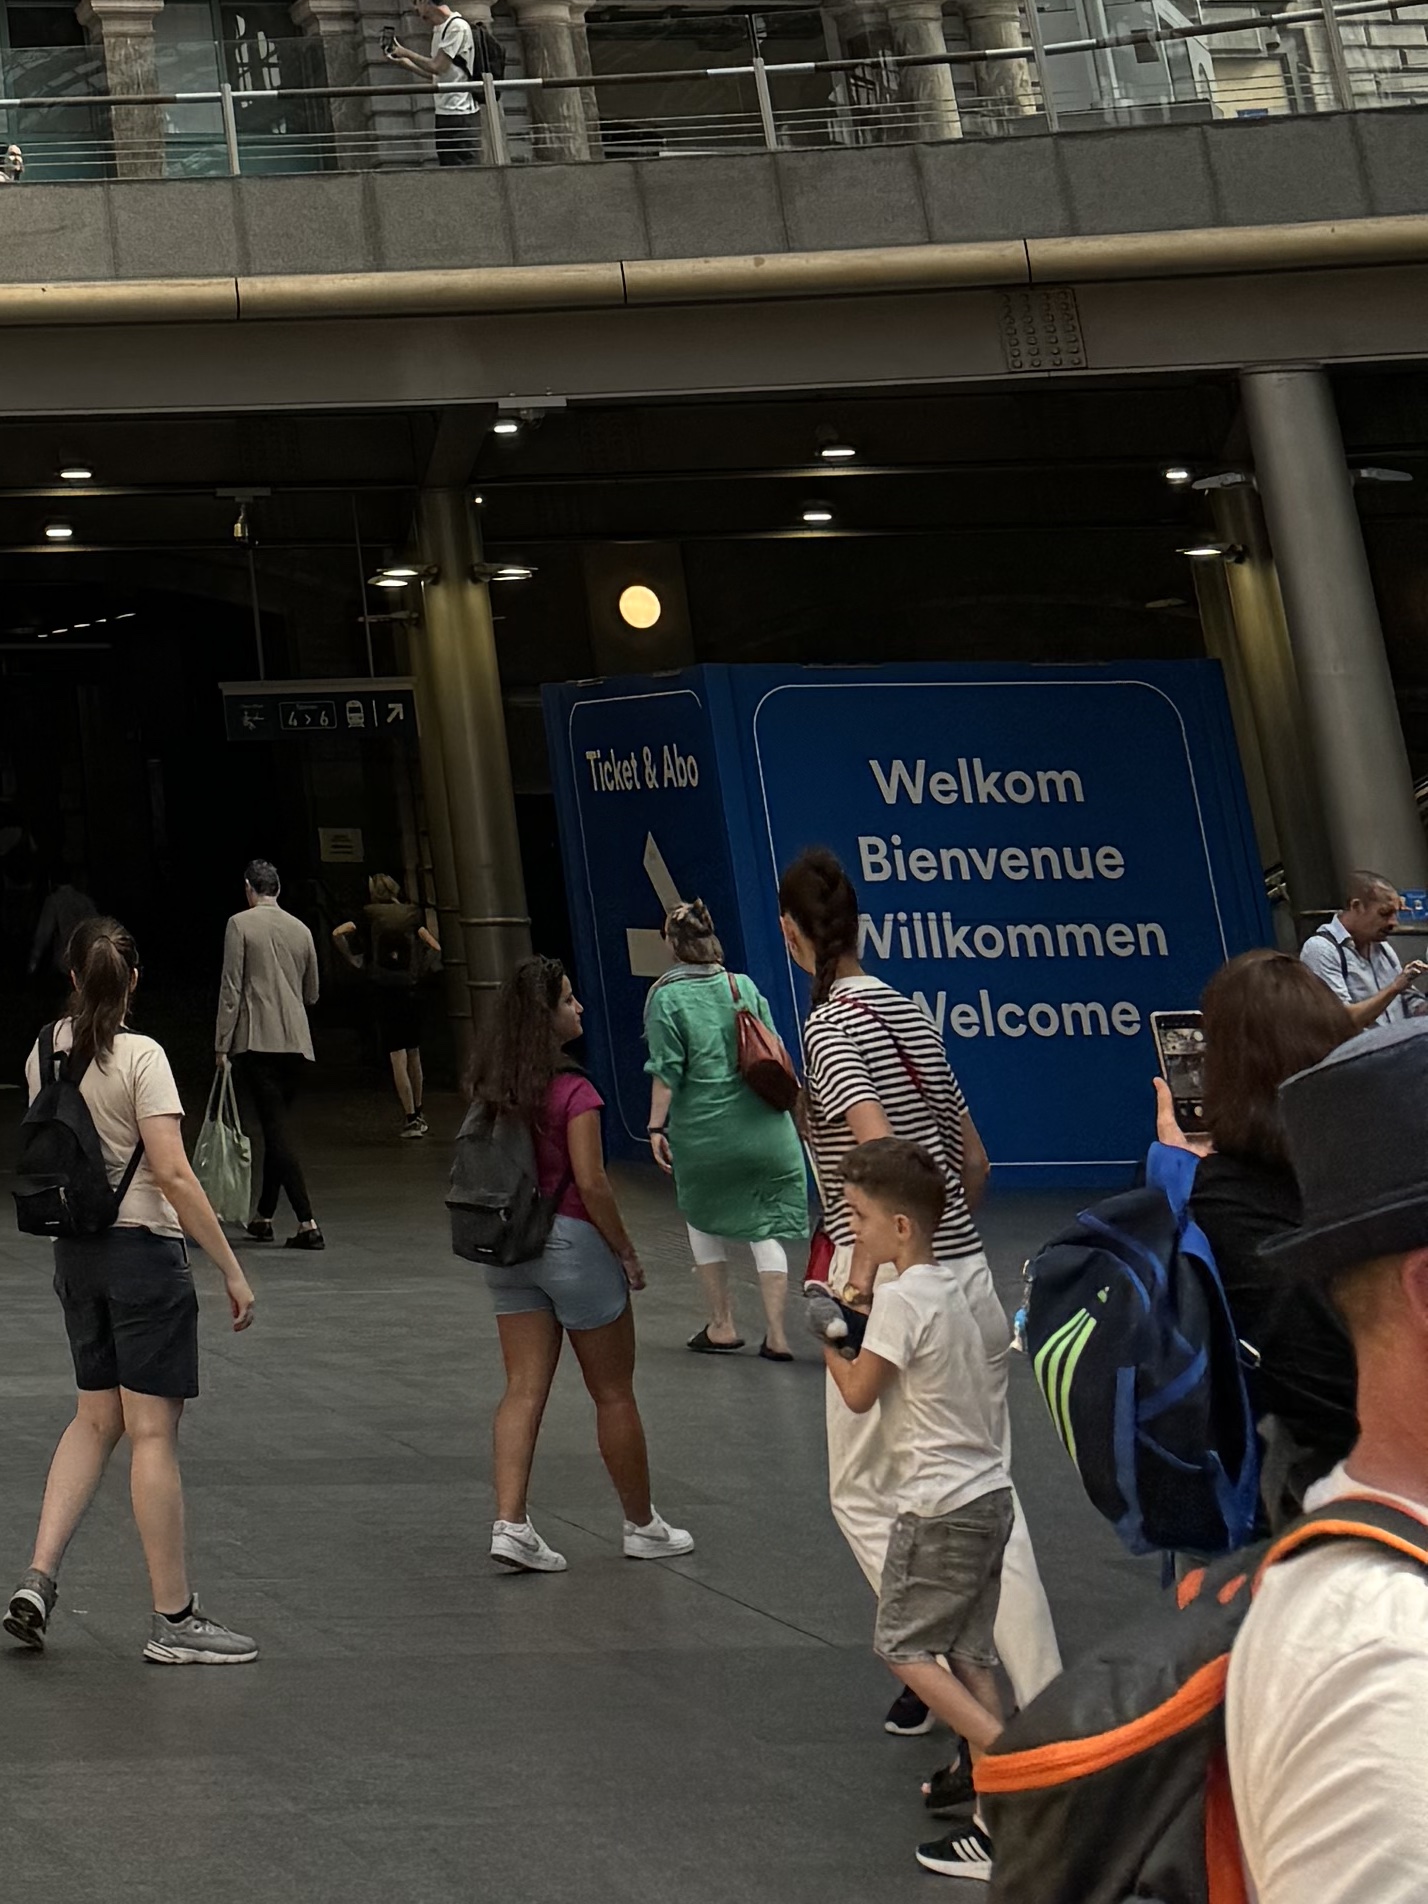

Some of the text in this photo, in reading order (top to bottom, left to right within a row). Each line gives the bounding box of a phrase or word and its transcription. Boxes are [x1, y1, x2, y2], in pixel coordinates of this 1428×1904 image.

[585, 742, 699, 792] Ticket & Abo
[867, 757, 1085, 806] Welkom
[856, 833, 1126, 883] Bienvenue
[857, 910, 1169, 960] Willkommen
